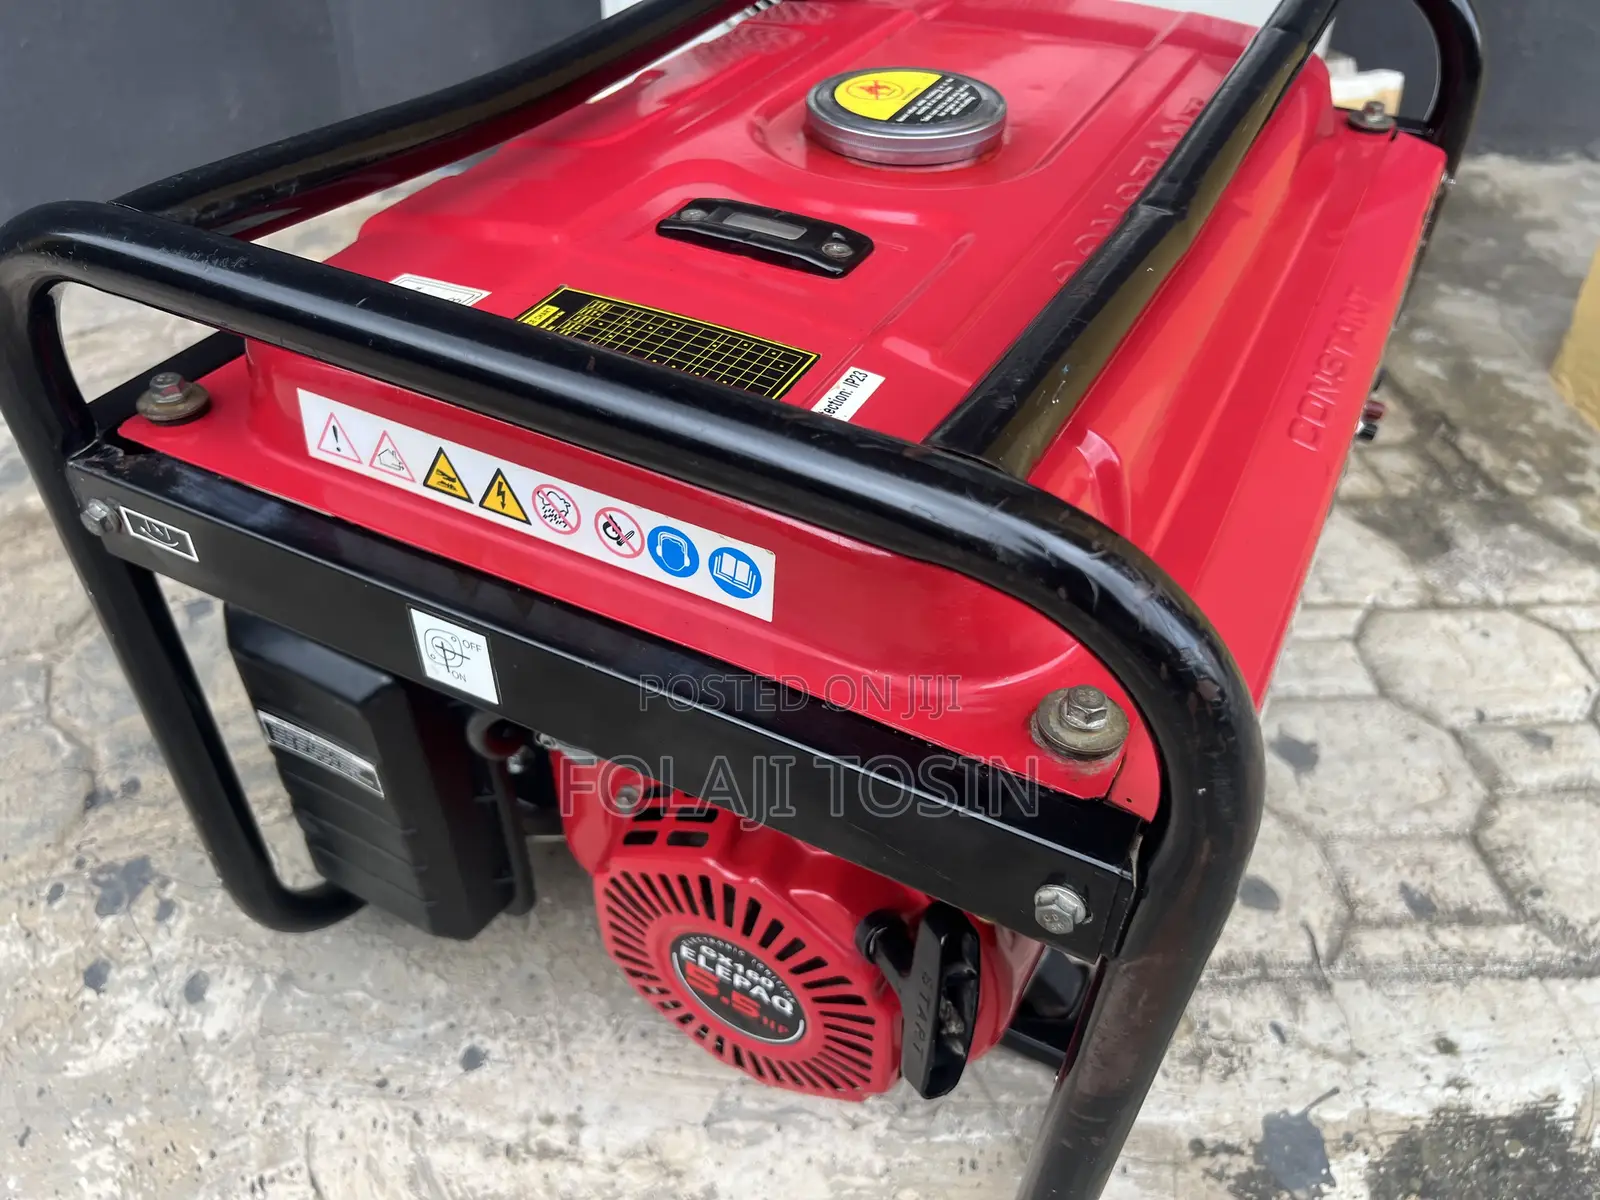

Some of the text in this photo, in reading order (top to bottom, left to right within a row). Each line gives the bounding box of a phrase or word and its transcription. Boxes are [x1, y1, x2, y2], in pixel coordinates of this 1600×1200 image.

[842, 370, 869, 389] IP23
[1286, 285, 1375, 452] CONSTANT
[461, 639, 482, 653] OFF
[451, 670, 467, 683] ON
[679, 944, 795, 1018] ELEPAQ
[699, 944, 775, 992] GX160
[912, 970, 934, 1061] START
